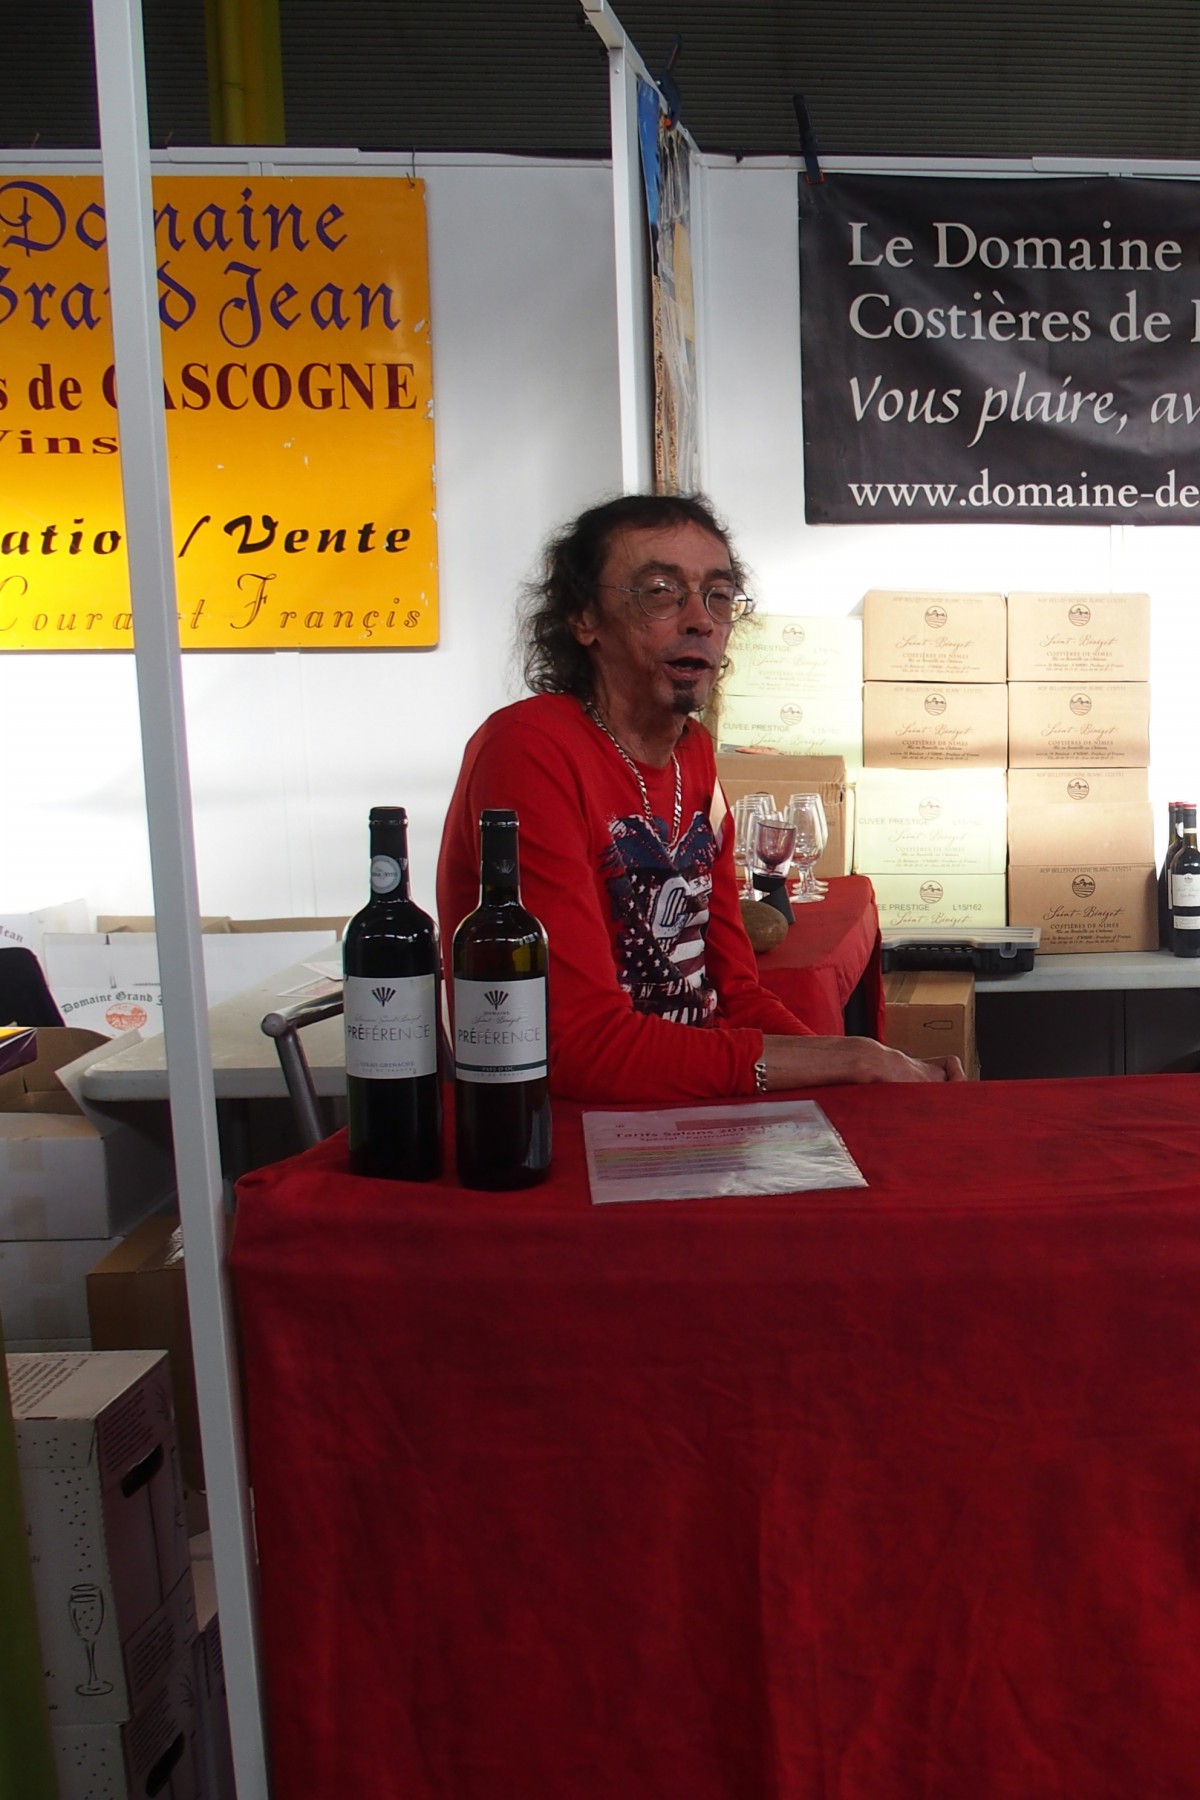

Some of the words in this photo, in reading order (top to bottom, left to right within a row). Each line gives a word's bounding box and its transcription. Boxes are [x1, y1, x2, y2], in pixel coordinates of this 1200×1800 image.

[848, 222, 914, 267] Le
[933, 220, 1183, 272] Domaine
[0, 261, 196, 332] rad
[219, 261, 401, 347] Jean
[849, 290, 1092, 342] Costières
[1110, 289, 1171, 342] de
[28, 363, 82, 411] de
[849, 374, 962, 424] Vous
[967, 370, 1128, 448] plaire,
[0, 430, 119, 454] ins
[223, 515, 411, 556] Vente
[889, 903, 930, 911] PRESTIGE
[952, 903, 982, 911] L15/162
[61, 996, 113, 1013] Domaine
[115, 991, 153, 1003] Grand
[347, 1023, 430, 1041] PRÉFÉRENCE
[458, 1027, 541, 1045] PRÉFÉRENCE
